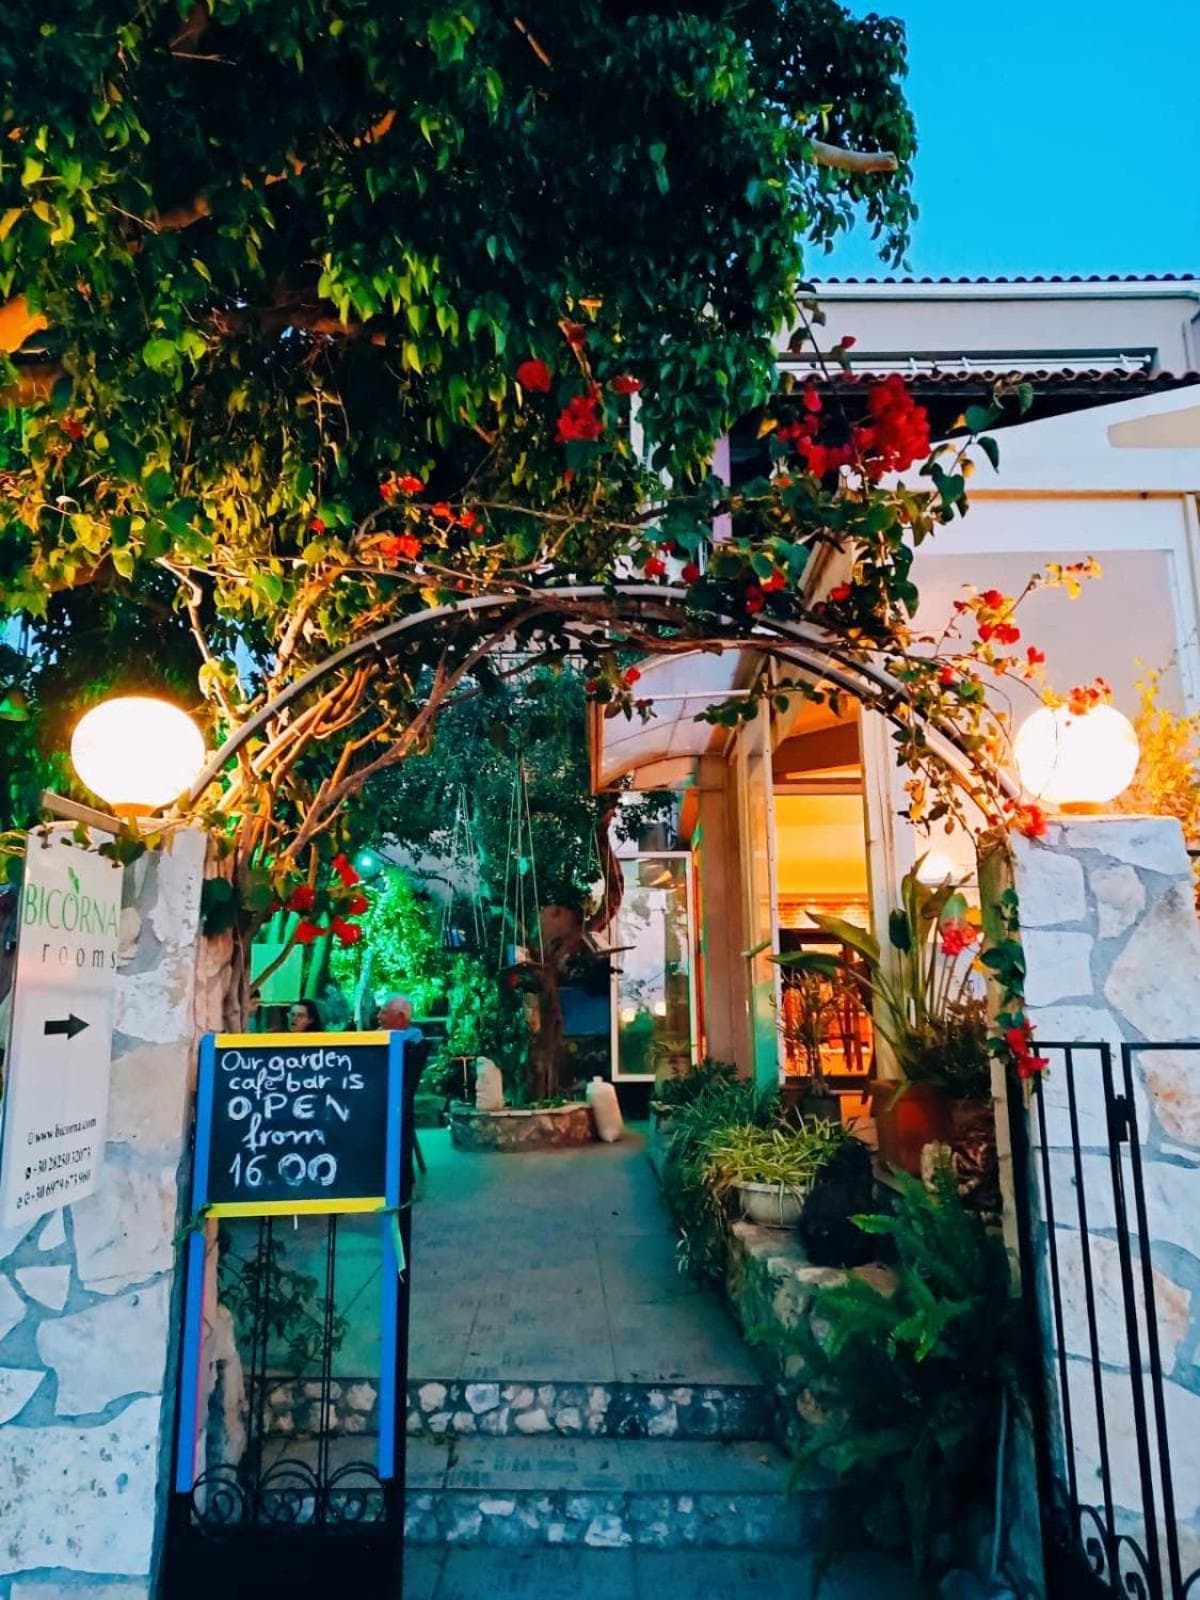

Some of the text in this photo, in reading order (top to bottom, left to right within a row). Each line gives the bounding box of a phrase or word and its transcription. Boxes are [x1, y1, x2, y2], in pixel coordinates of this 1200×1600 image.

[24, 883, 118, 937] BICORNA
[42, 943, 116, 969] rooms
[221, 1049, 352, 1081] Our garden
[286, 1072, 332, 1092] bar
[342, 1073, 365, 1090] is
[228, 1093, 350, 1122] OPEN
[241, 1113, 326, 1154] from
